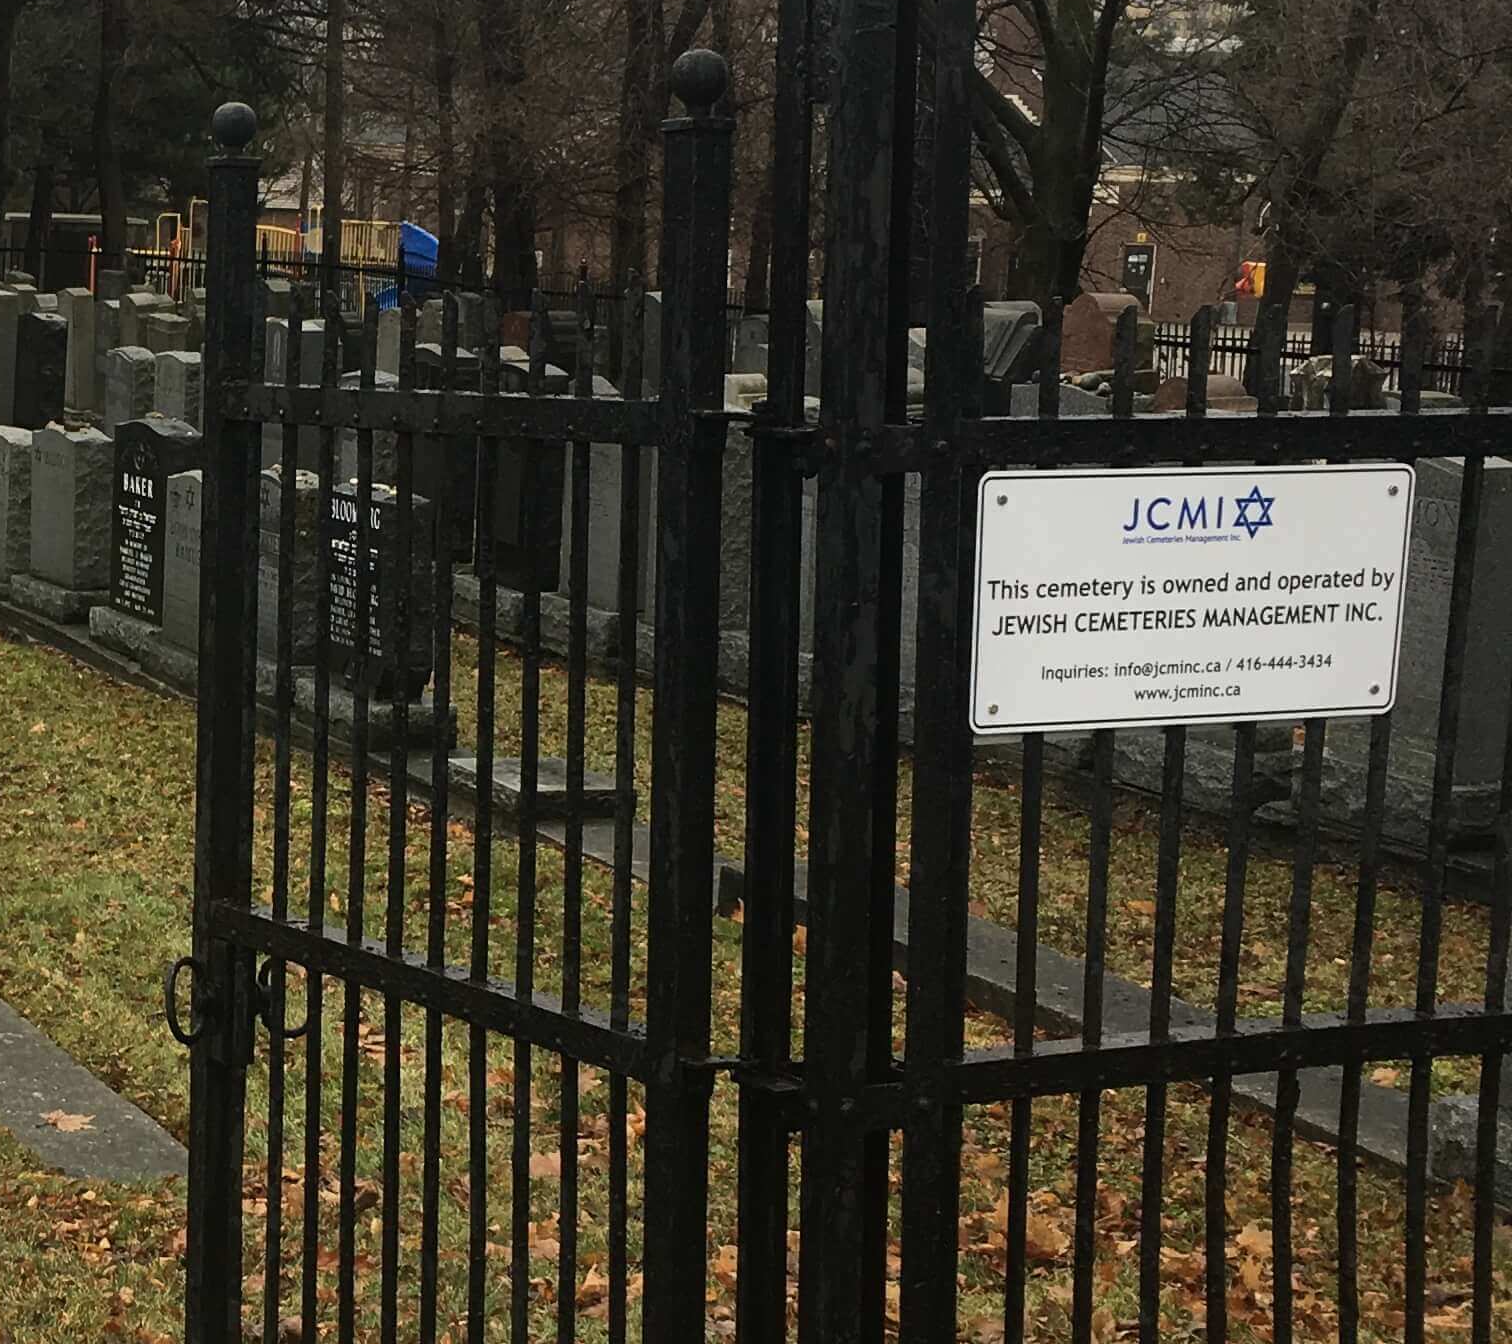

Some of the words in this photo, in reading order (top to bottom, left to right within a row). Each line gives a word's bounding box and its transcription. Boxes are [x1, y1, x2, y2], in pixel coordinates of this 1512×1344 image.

[123, 472, 154, 498] BAKER
[1123, 496, 1223, 531] JCMI
[1122, 536, 1145, 544] Jewish
[1147, 535, 1184, 544] Cemeteries
[1185, 534, 1229, 544] Management
[987, 580, 1029, 600] This
[1036, 578, 1134, 600] cemetery
[1141, 576, 1156, 595] is
[1163, 572, 1229, 594] owned
[1235, 571, 1271, 592] and
[1278, 568, 1365, 595] operated
[1371, 568, 1394, 592] by
[992, 614, 1067, 636] JEWISH
[1075, 609, 1197, 633] CEMETERIES
[1202, 603, 1340, 628] MANAGEMENT
[1345, 602, 1383, 622] INC.
[1041, 664, 1110, 683] Inquiries:
[1114, 659, 1221, 678] info@jcminc.ca
[1225, 658, 1233, 672] /
[1236, 654, 1332, 672] 416-444-3434
[1134, 684, 1241, 702] www.jcminc.ca
